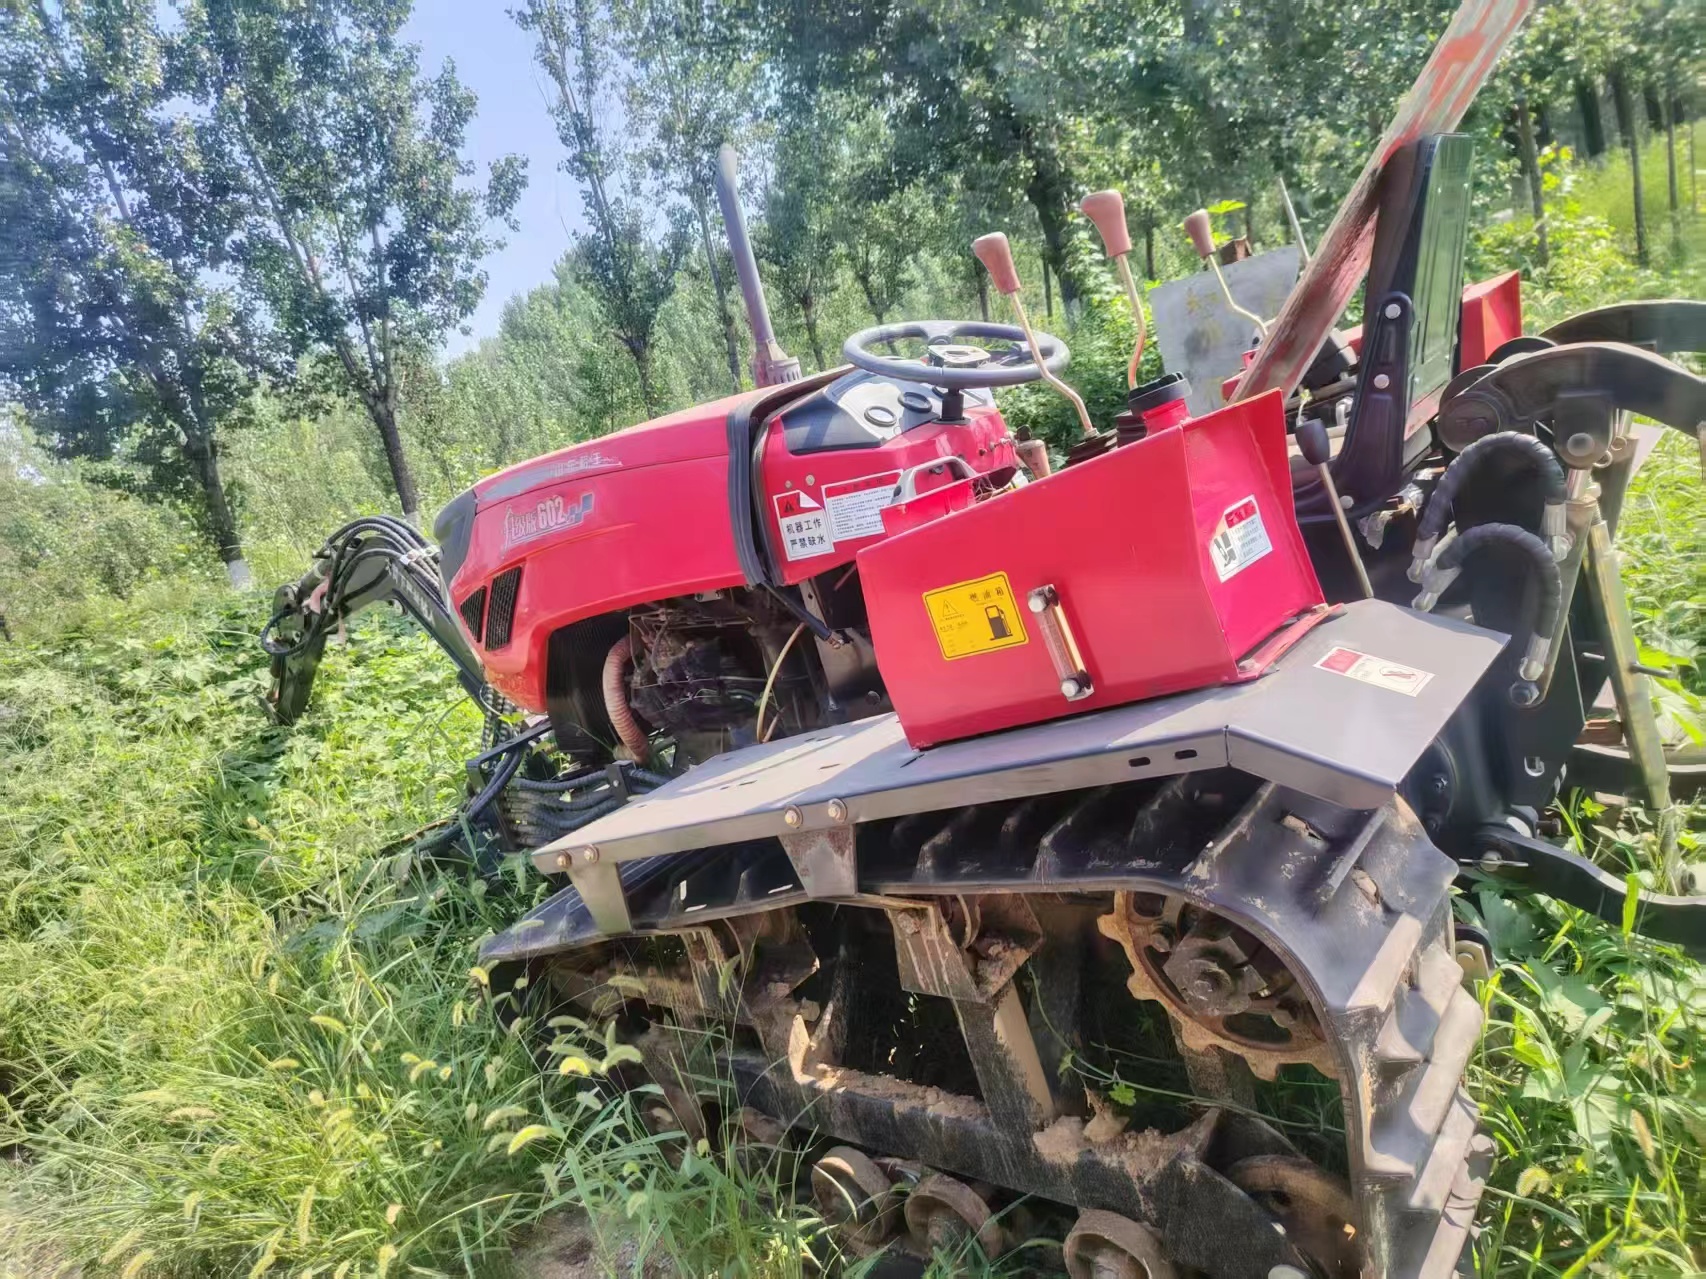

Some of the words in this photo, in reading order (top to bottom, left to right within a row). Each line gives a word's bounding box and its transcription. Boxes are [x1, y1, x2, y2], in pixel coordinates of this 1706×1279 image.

[786, 517, 822, 534] 机器工作
[789, 533, 826, 551] 严禁缺水
